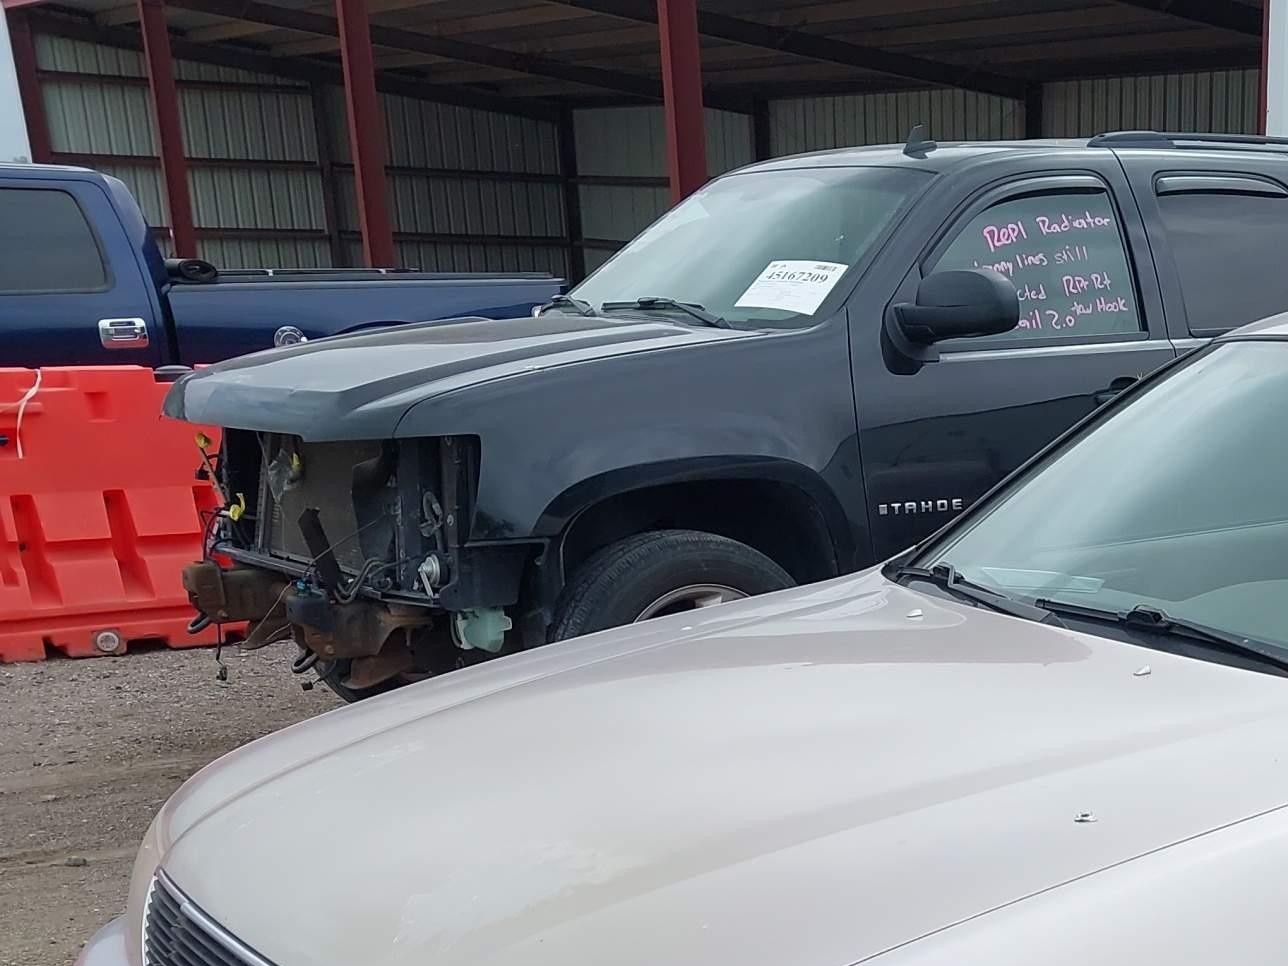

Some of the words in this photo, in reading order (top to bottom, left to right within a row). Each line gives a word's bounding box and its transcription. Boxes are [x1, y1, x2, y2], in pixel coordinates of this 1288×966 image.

[1036, 210, 1111, 236] Radiator
[1054, 246, 1089, 265] still
[765, 271, 829, 284] 45167209
[1016, 283, 1047, 300] cted
[1096, 296, 1129, 313] Hook
[1014, 309, 1042, 330] ail
[1045, 310, 1075, 330] 2.0
[890, 498, 964, 515] TAHOE
